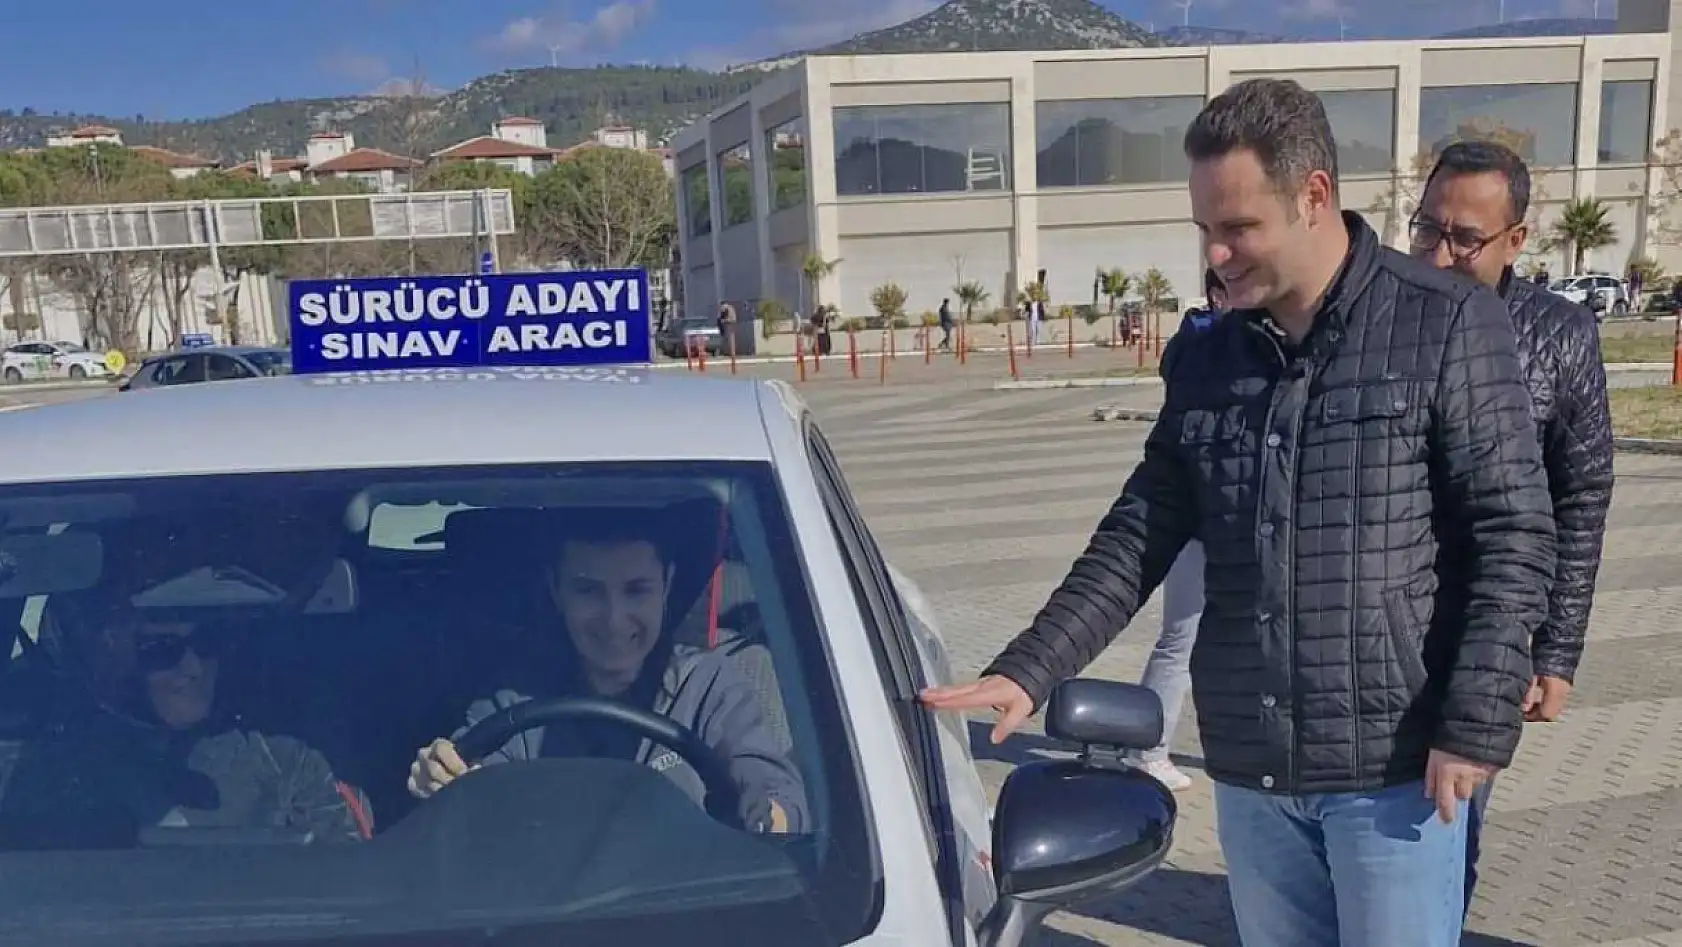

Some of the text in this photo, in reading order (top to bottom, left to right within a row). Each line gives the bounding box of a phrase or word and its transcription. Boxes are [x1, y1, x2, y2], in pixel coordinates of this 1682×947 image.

[299, 278, 640, 326] SÜRÜCÜ ADAYI
[321, 319, 628, 360] SINAV ARACI
